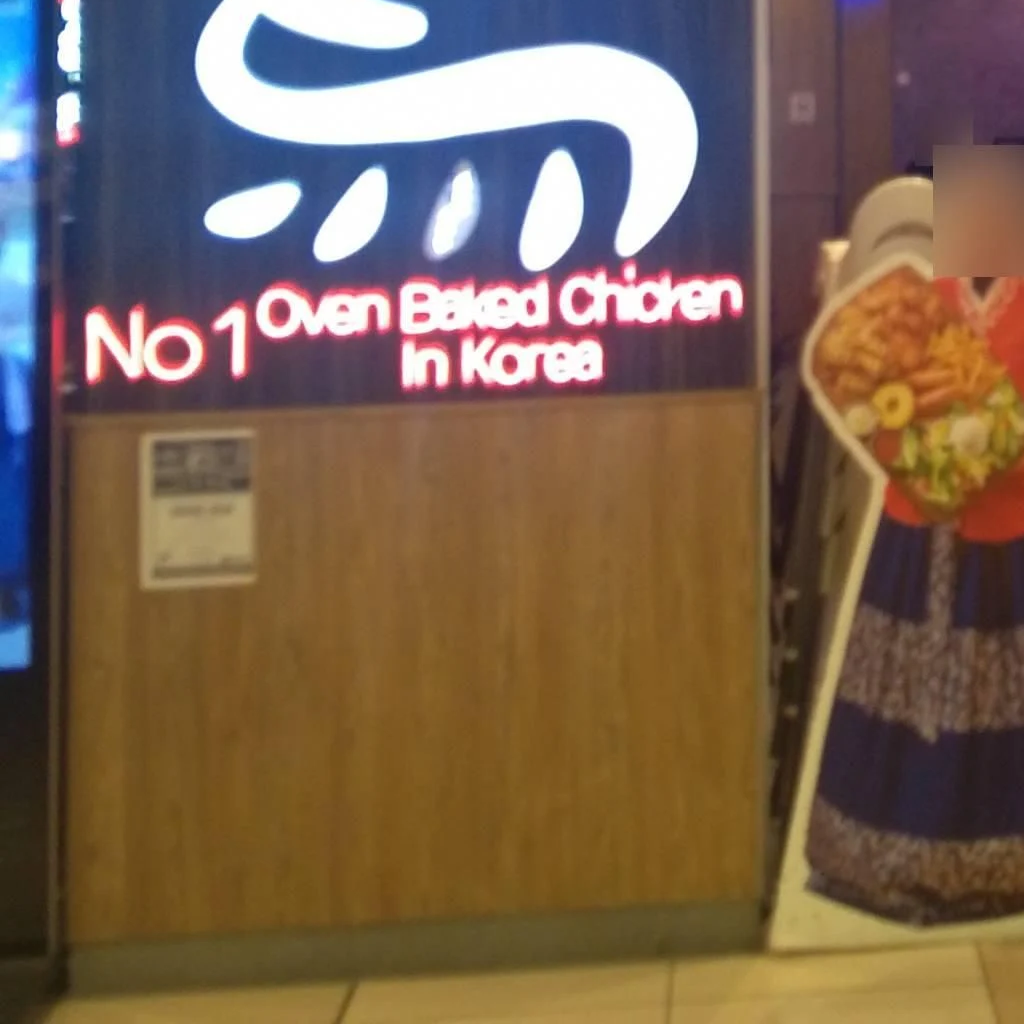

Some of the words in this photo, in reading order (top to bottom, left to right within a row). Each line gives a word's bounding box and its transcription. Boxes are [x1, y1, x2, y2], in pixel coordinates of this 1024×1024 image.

[255, 282, 392, 341] Oven
[399, 275, 550, 336] Baked
[557, 262, 745, 328] Chicken
[84, 304, 206, 385] No
[460, 331, 606, 389] Korea
